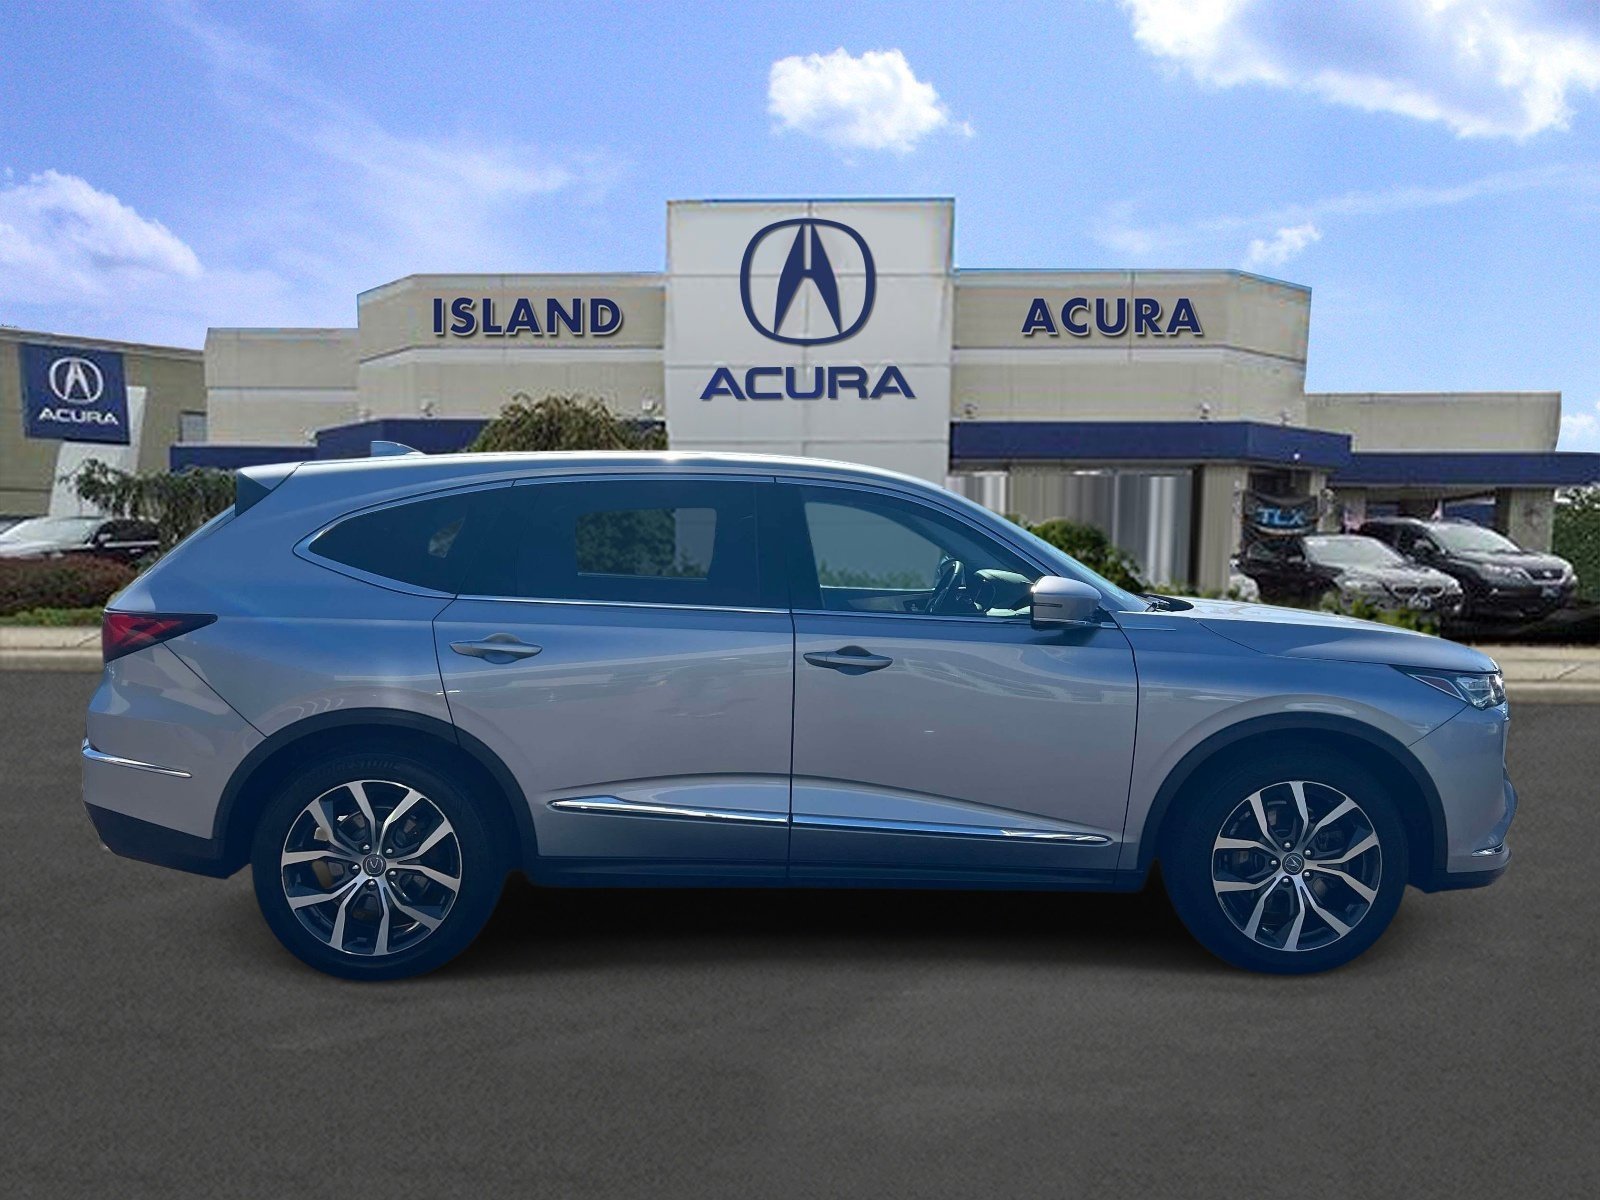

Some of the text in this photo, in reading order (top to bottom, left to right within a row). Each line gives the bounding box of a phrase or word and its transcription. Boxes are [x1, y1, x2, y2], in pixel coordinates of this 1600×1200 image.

[433, 297, 623, 337] ISLAND
[1022, 297, 1204, 337] ACURA
[700, 365, 916, 401] ACURA
[39, 407, 119, 425] ACURA
[1257, 507, 1306, 526] TLX
